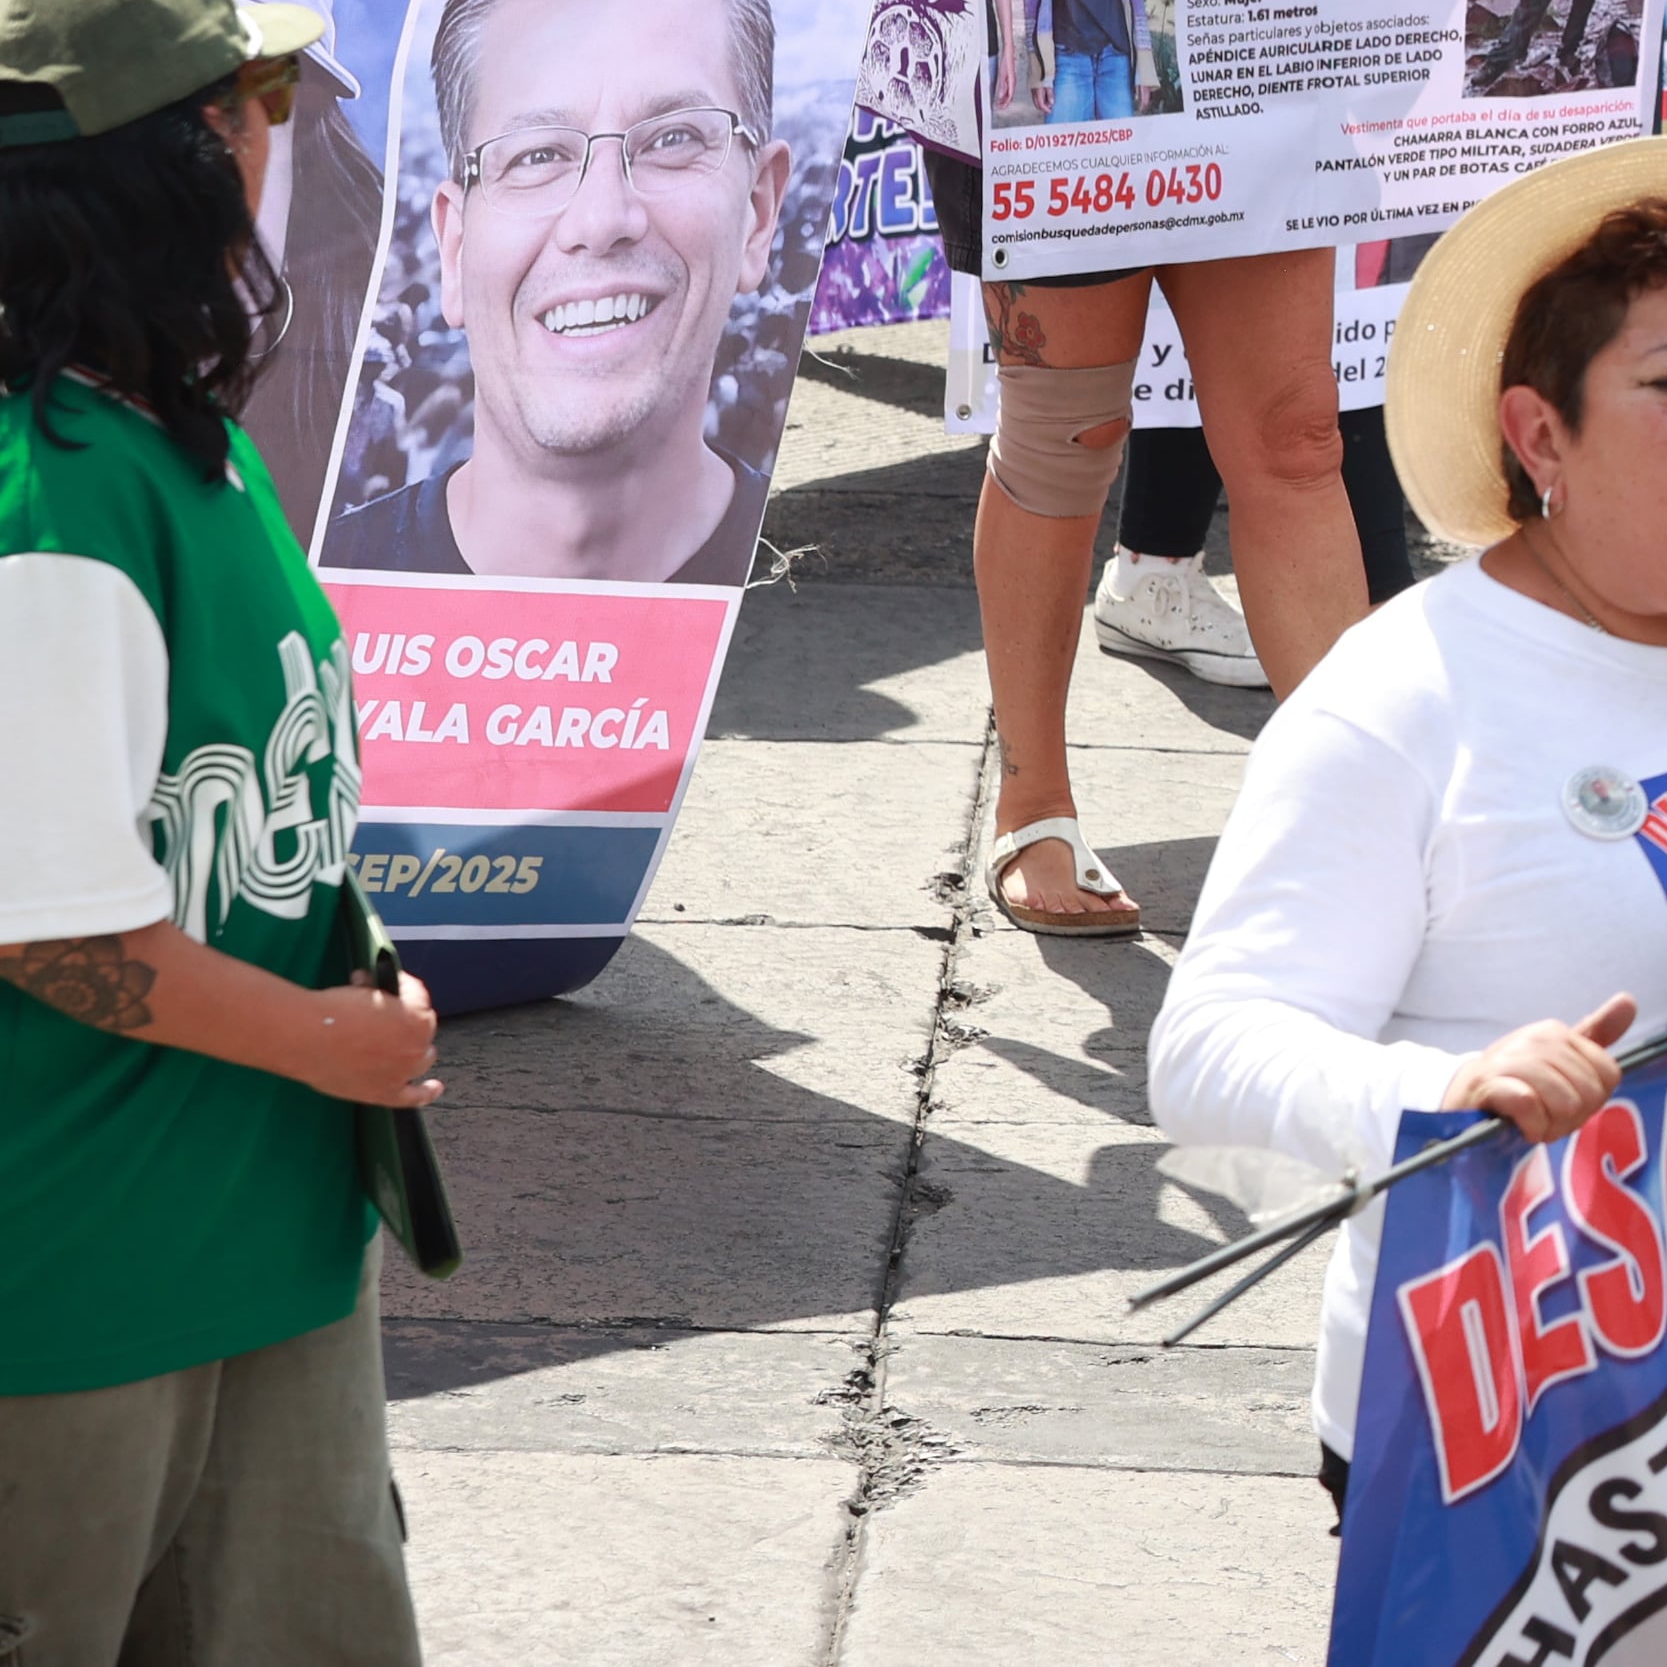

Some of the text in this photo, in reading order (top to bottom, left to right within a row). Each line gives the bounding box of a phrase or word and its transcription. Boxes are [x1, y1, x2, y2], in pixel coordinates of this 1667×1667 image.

[991, 161, 1223, 222] 55 5484 0430
[443, 632, 620, 685] OSCAR
[484, 698, 671, 752] GARCÍA
